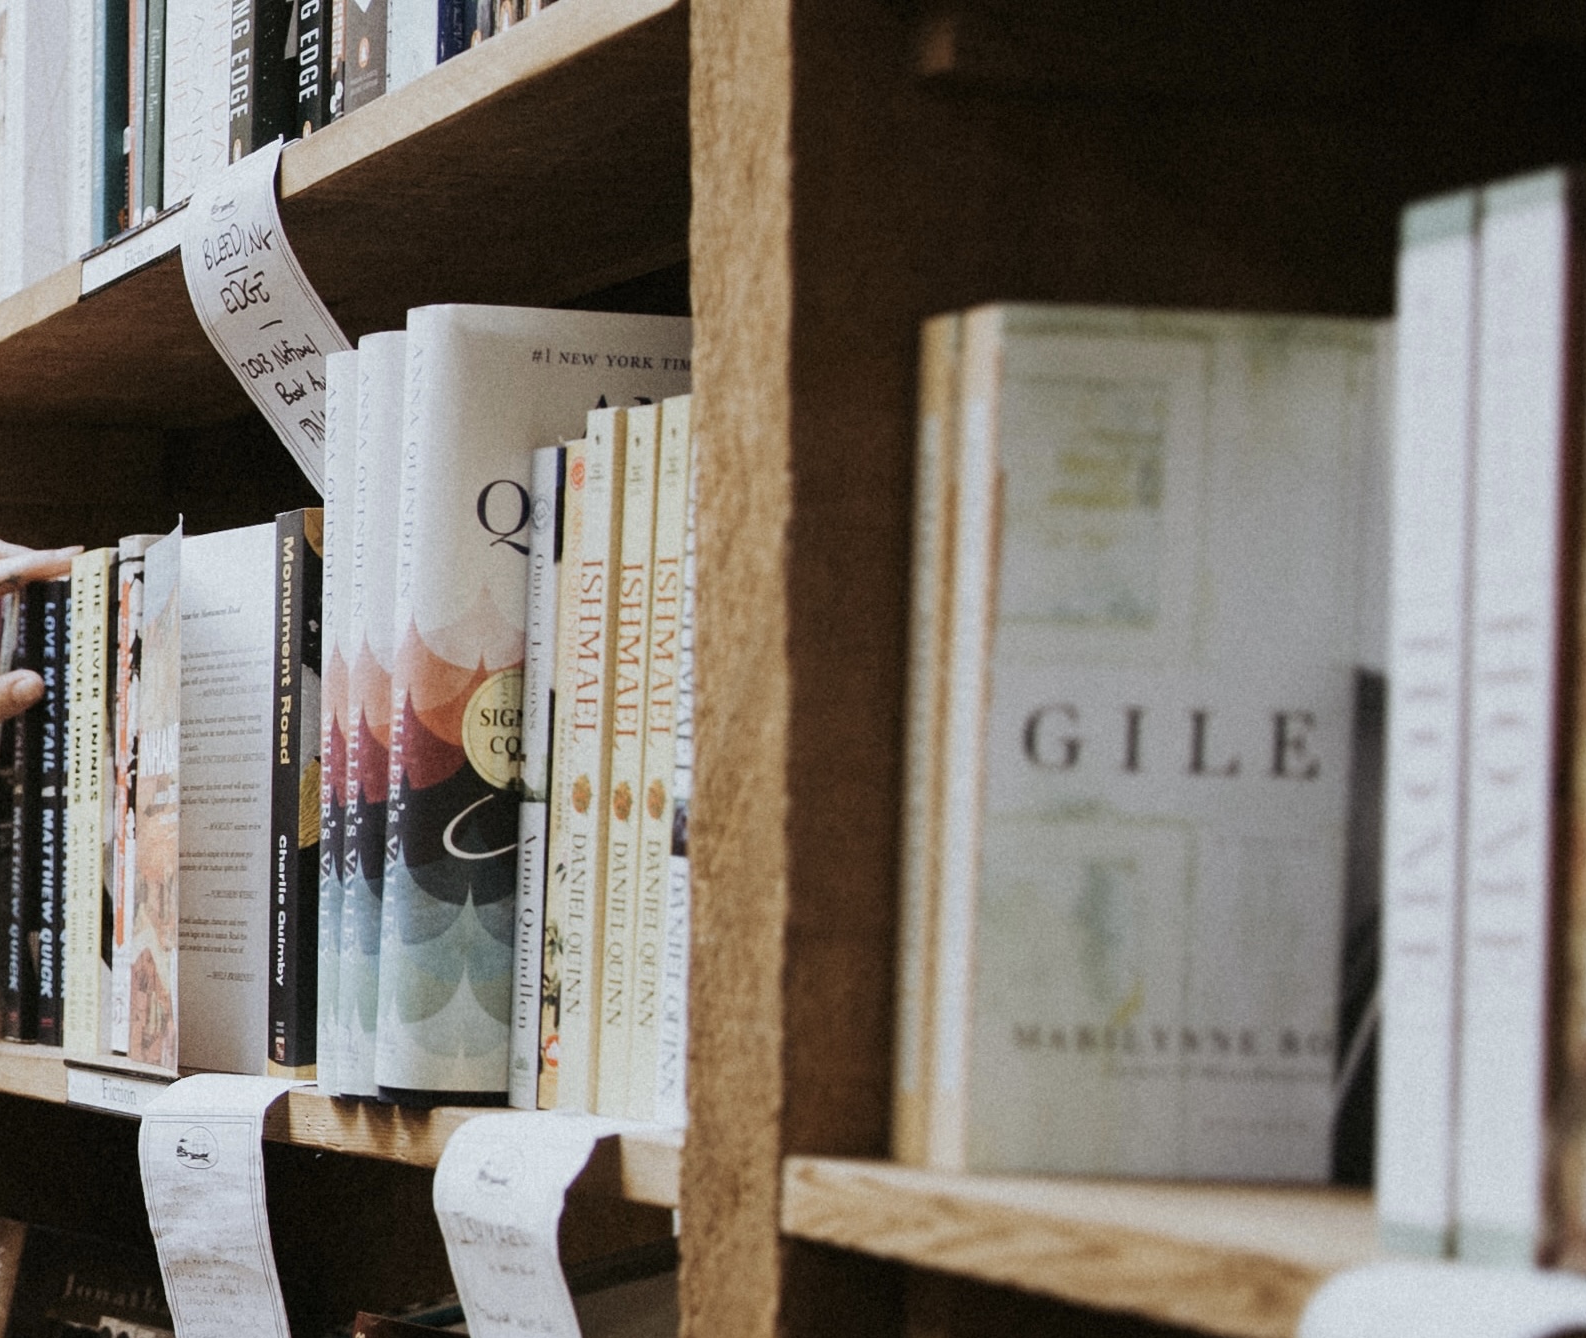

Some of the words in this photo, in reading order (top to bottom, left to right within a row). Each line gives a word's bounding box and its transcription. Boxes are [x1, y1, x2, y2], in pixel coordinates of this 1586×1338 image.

[229, 49, 250, 122] EDGE
[298, 30, 320, 103] EDGE
[146, 93, 157, 123] Pym
[125, 245, 156, 269] Fiction
[202, 222, 273, 270] BLEEDING
[220, 272, 272, 315] EDGE
[241, 353, 275, 379] 2013
[272, 334, 322, 374] National
[275, 379, 307, 406] Book
[410, 345, 424, 427] ANNA
[532, 348, 550, 363] #1
[559, 351, 598, 366] NEW
[605, 354, 653, 370] YORK
[327, 388, 338, 462] ANNA
[357, 373, 369, 450] ANNA
[323, 477, 335, 626] QUINDLEN
[353, 465, 367, 617] QUINDLEN
[400, 441, 418, 600] QUINDLEN
[76, 578, 85, 616] THE
[93, 572, 102, 611] THE
[280, 536, 295, 687] Monument
[43, 602, 57, 667] LOVE
[75, 630, 84, 702] SILVER
[91, 625, 102, 700] SILVER
[573, 559, 604, 744] ISHMAEL
[614, 563, 644, 750] ISHMAEL
[648, 557, 679, 747] ISHMAEL
[41, 722, 56, 774] FAIL
[73, 715, 82, 804] LININGS
[89, 710, 100, 801] LININGS
[279, 695, 291, 765] Road
[1020, 699, 1324, 782] GILE
[9, 807, 23, 919] MATTHEW
[40, 808, 55, 924] MATTHEW
[276, 834, 288, 904] Charlie
[383, 833, 401, 953] VALLEY
[520, 835, 538, 897] Anna
[568, 833, 587, 924] DANIEL
[611, 842, 628, 931] DANIEL
[645, 839, 661, 931] DANIEL
[318, 852, 332, 962] VALLEY
[342, 850, 360, 967] VALLEY
[7, 924, 21, 993] QUICK
[38, 927, 55, 999] QUICK
[274, 910, 287, 986] Quimby
[517, 906, 535, 1030] Quindlen
[565, 930, 583, 1017] QUINN
[607, 939, 625, 1028] QUINN
[639, 941, 657, 1028] QUINN
[102, 1077, 137, 1106] Fiction
